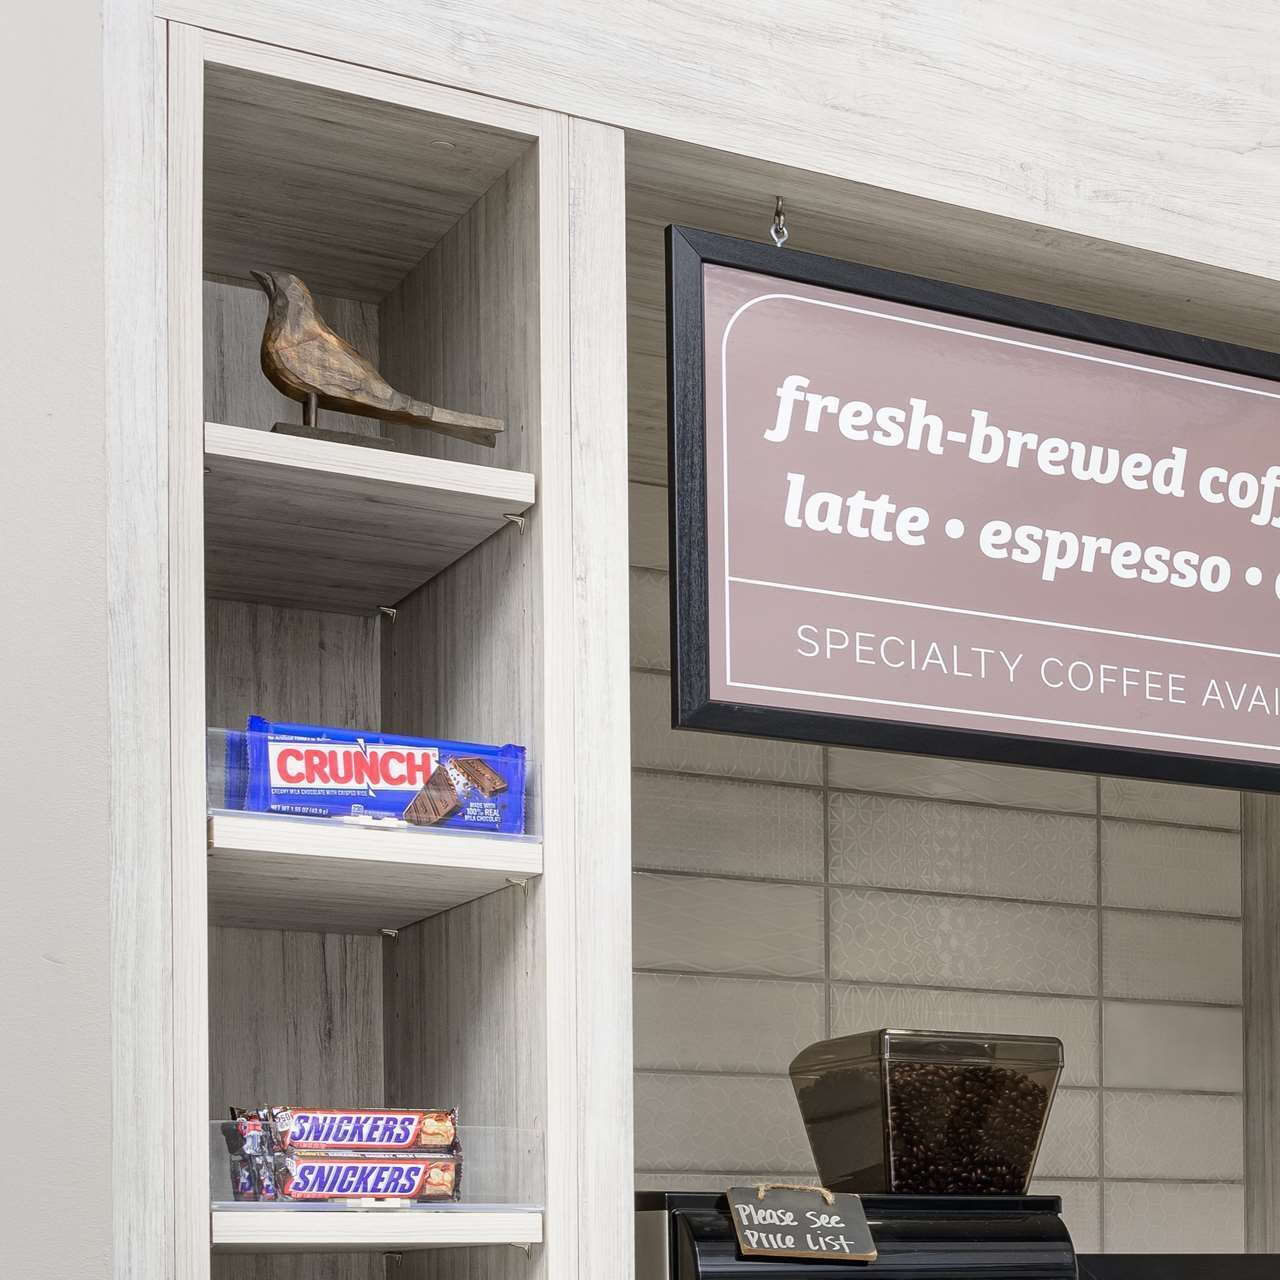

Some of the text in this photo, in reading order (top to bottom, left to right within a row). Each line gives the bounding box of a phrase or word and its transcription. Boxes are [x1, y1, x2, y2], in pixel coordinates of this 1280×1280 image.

[764, 375, 1187, 499] fresh-brewed
[784, 474, 929, 546] latte
[979, 519, 1232, 594] espresso
[796, 623, 1028, 683] SPECIALTY
[1040, 657, 1189, 705] COFFEE
[276, 748, 432, 786] CRUNCH
[290, 1114, 414, 1143] SNICKERS
[292, 1164, 421, 1193] SNICKERS
[735, 1204, 798, 1227] Please
[744, 1229, 795, 1249] Price
